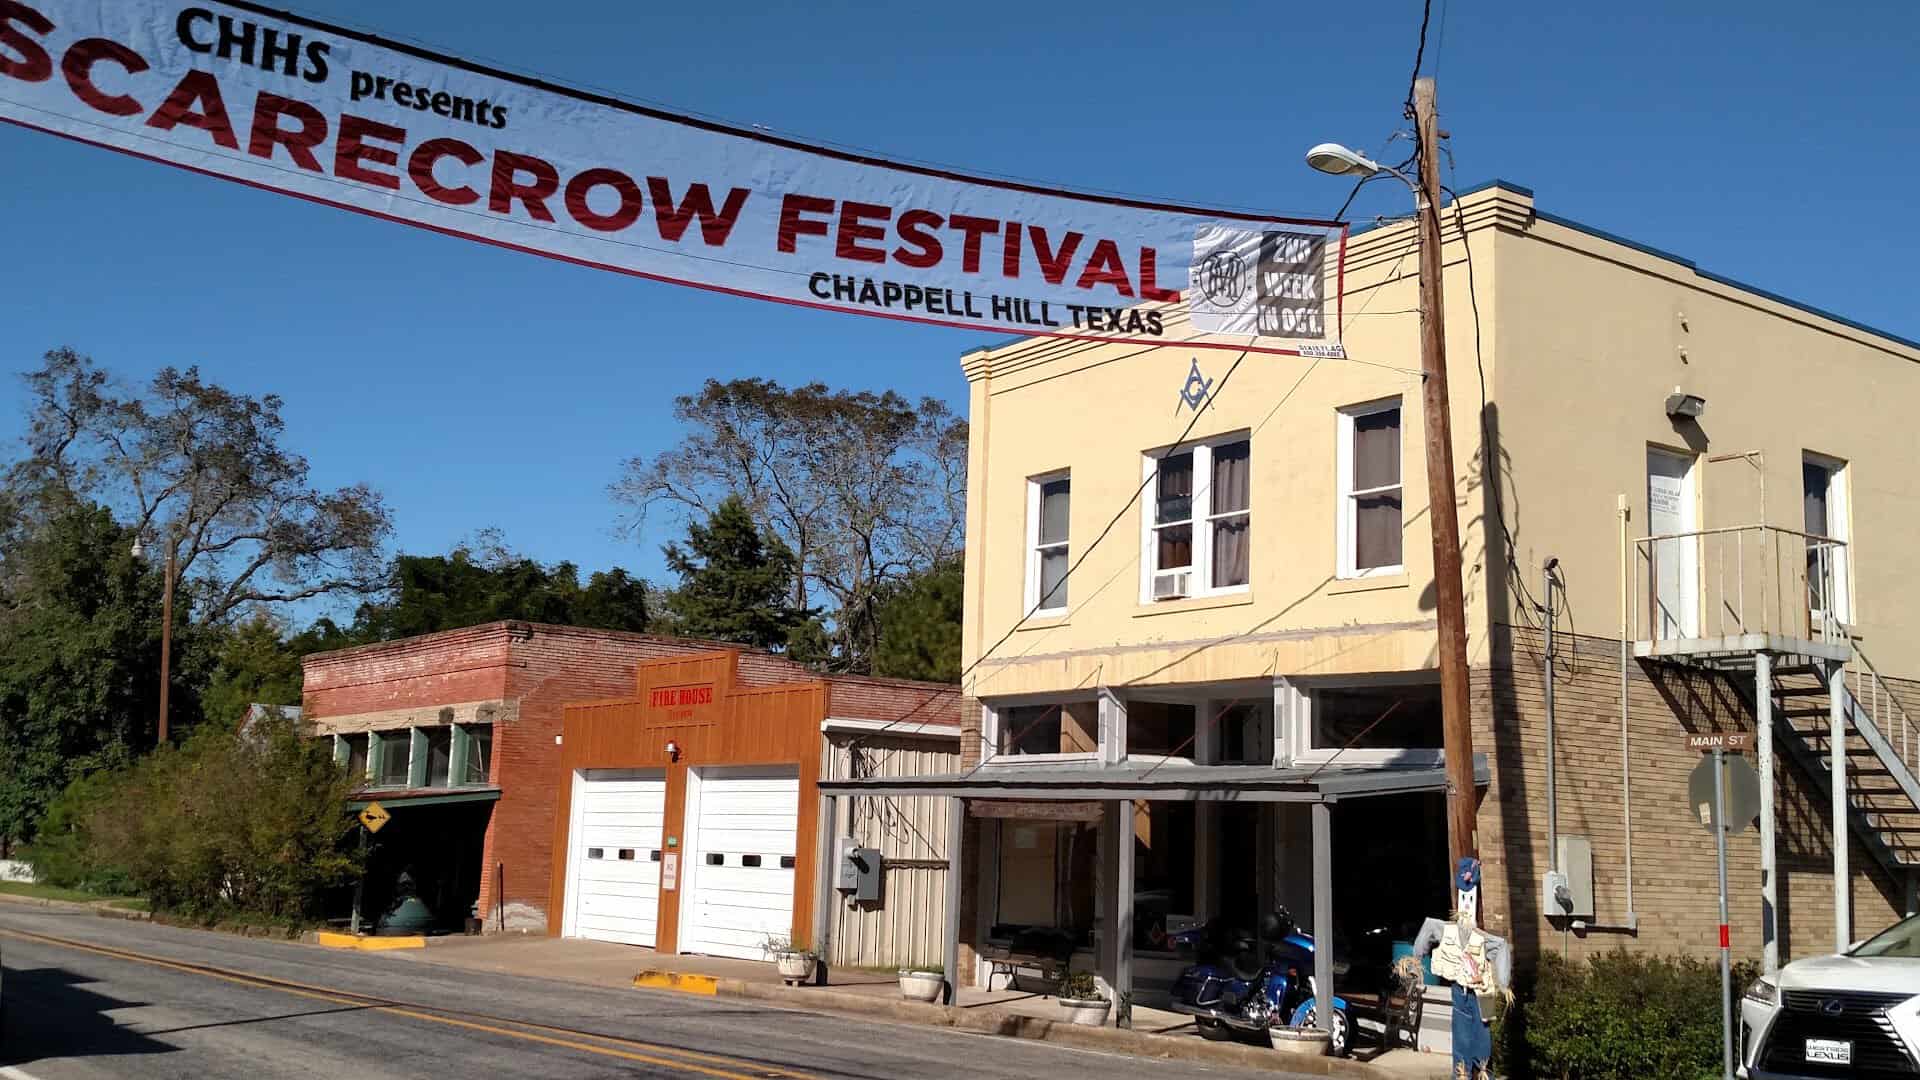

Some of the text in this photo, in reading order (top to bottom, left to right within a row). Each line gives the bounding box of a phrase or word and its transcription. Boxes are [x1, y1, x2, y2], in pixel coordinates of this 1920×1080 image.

[176, 7, 508, 130] CHHS presents
[0, 0, 1180, 304] SCARECROW FESTIVAL
[1264, 271, 1316, 299] WEEK
[808, 271, 1163, 337] CHAPPELL HILL TEXAS
[1258, 304, 1279, 332] IN
[651, 687, 713, 707] FIRE HOUSE
[1690, 735, 1747, 746] MAIN ST
[1806, 1051, 1849, 1060] LEXUS
